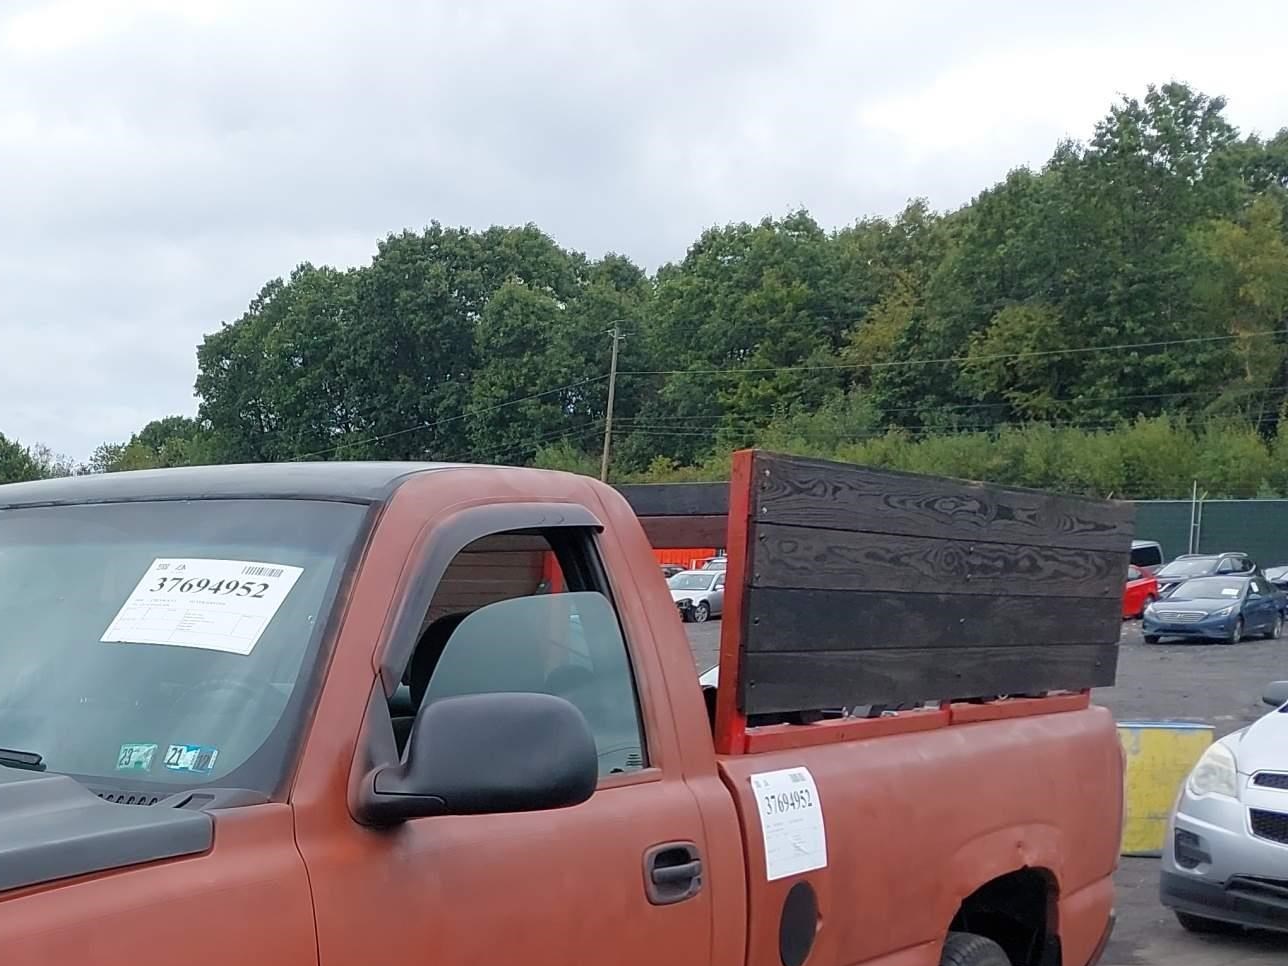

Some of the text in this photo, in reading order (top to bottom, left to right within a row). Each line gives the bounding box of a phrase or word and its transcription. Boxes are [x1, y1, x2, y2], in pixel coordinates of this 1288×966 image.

[150, 577, 270, 598] 37694952
[167, 748, 183, 766] 21
[765, 789, 812, 815] 37694952
